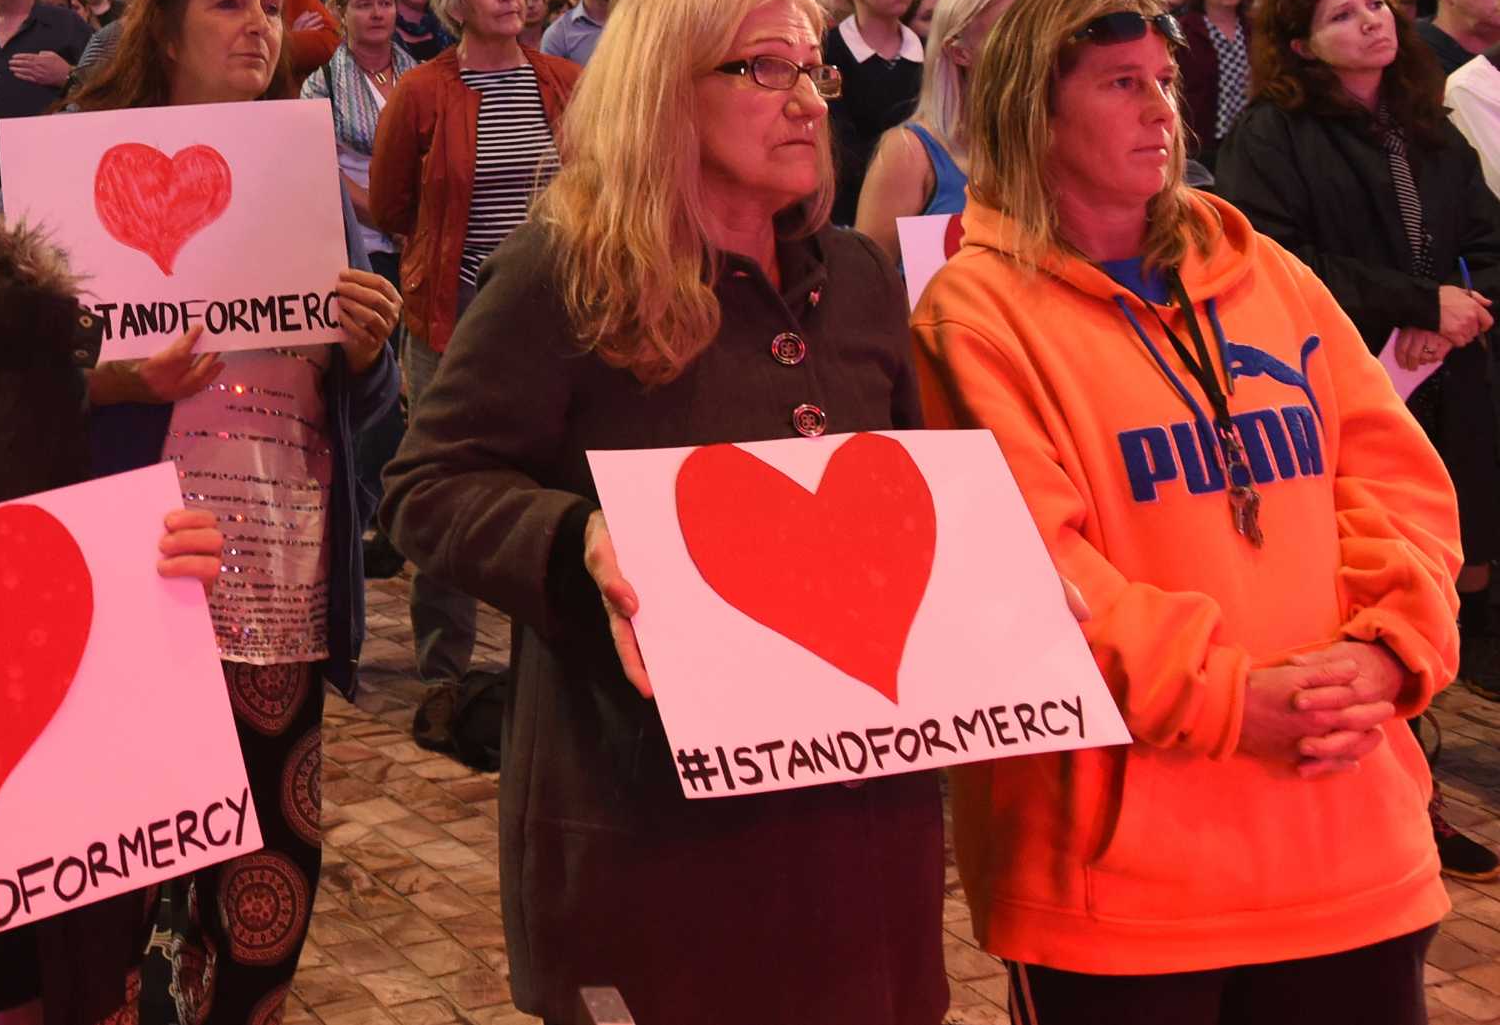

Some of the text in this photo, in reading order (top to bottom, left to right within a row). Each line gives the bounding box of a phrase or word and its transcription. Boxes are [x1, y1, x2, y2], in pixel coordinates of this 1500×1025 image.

[80, 291, 341, 341] TANDFORMERC
[1118, 406, 1323, 502] PUMA
[677, 695, 1087, 792] #ISTANDFORMERCY
